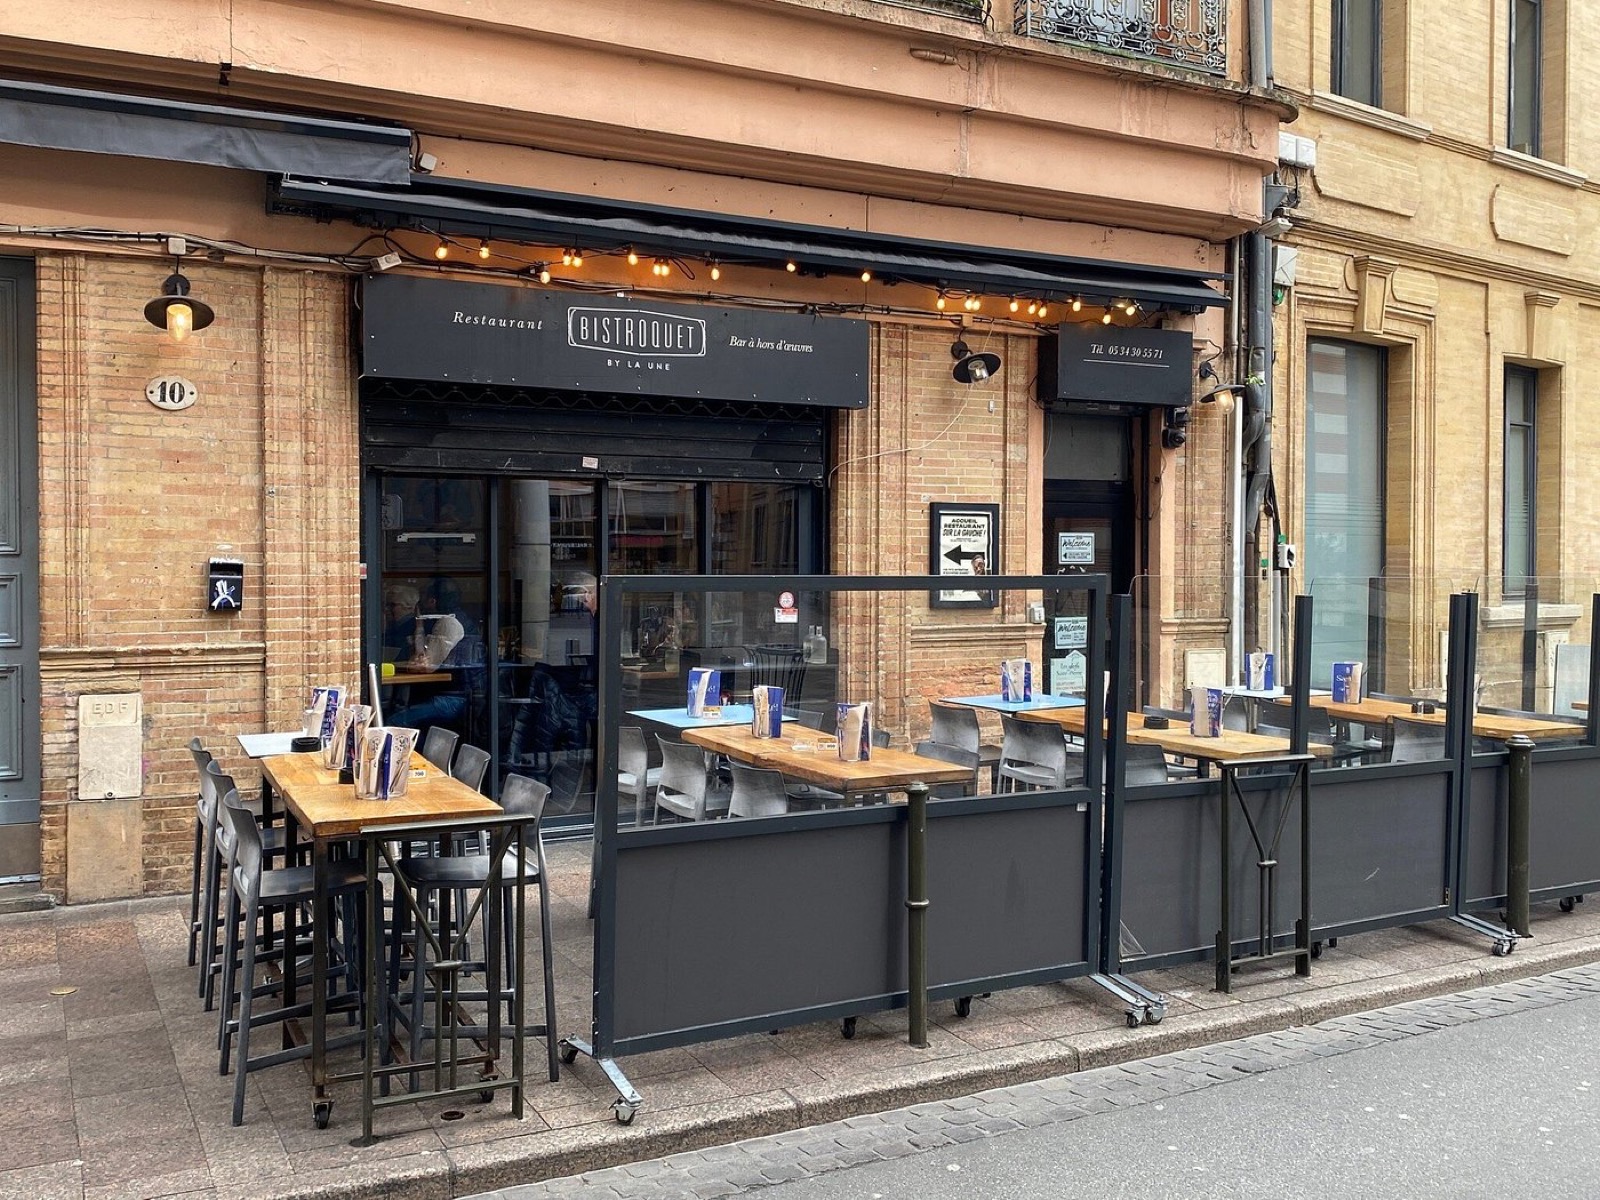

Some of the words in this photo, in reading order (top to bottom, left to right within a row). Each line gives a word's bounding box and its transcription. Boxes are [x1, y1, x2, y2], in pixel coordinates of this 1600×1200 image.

[452, 311, 543, 330] Restaurant
[579, 316, 695, 349] BISTROQUET
[729, 335, 747, 347] Bar
[748, 337, 756, 348] à
[756, 337, 775, 350] hors
[1108, 345, 1119, 355] 05
[1119, 346, 1130, 357] 34
[1130, 347, 1141, 358] 30
[1142, 348, 1152, 359] 55
[1153, 349, 1163, 359] 71
[607, 359, 620, 367] BY
[627, 360, 641, 369] LA
[647, 362, 671, 371] UNE
[157, 381, 185, 404] 10
[953, 529, 961, 537] LA
[92, 703, 129, 714] EDF
